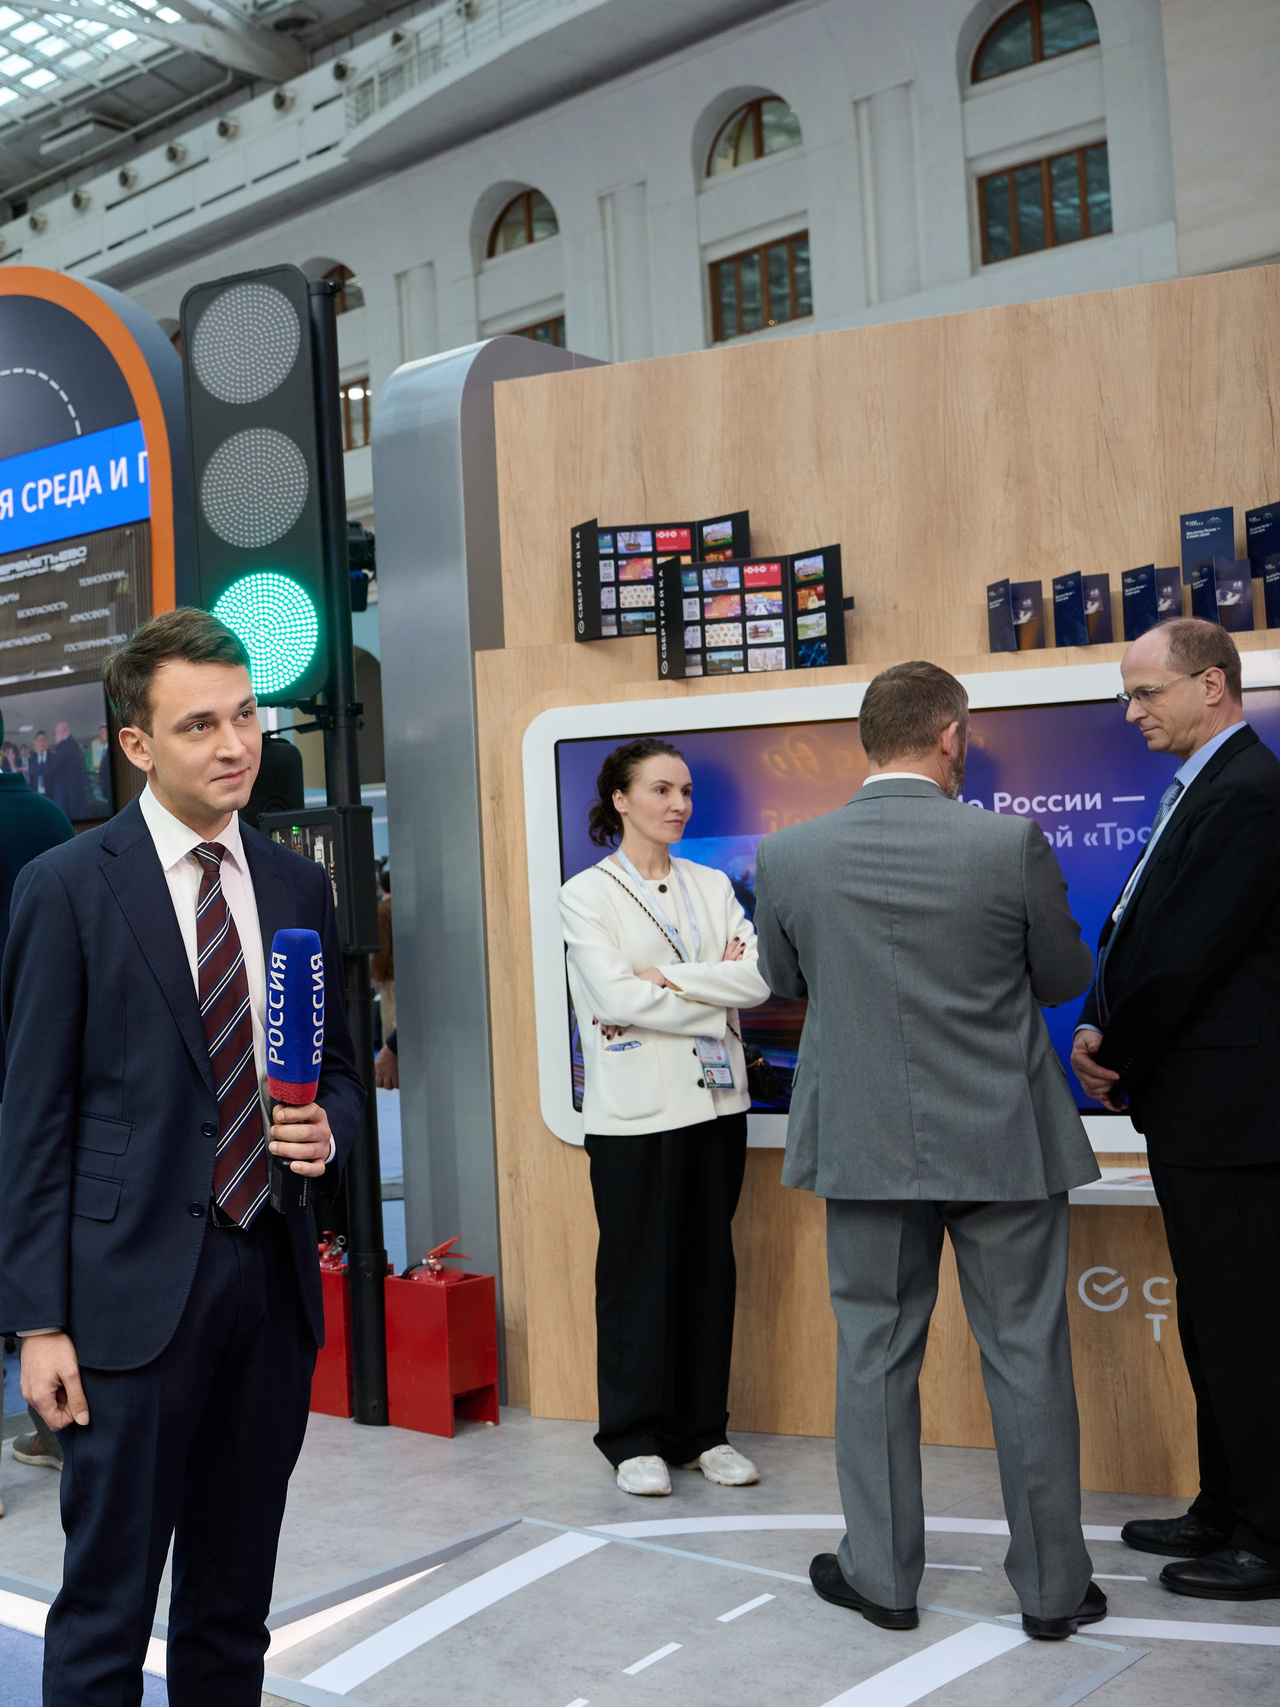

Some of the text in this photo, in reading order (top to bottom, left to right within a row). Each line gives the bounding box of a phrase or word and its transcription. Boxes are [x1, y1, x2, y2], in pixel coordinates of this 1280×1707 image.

[21, 465, 103, 513] СРЕДА
[110, 456, 128, 491] И
[993, 792, 1102, 815] России
[268, 952, 287, 1065] РОССИЯ
